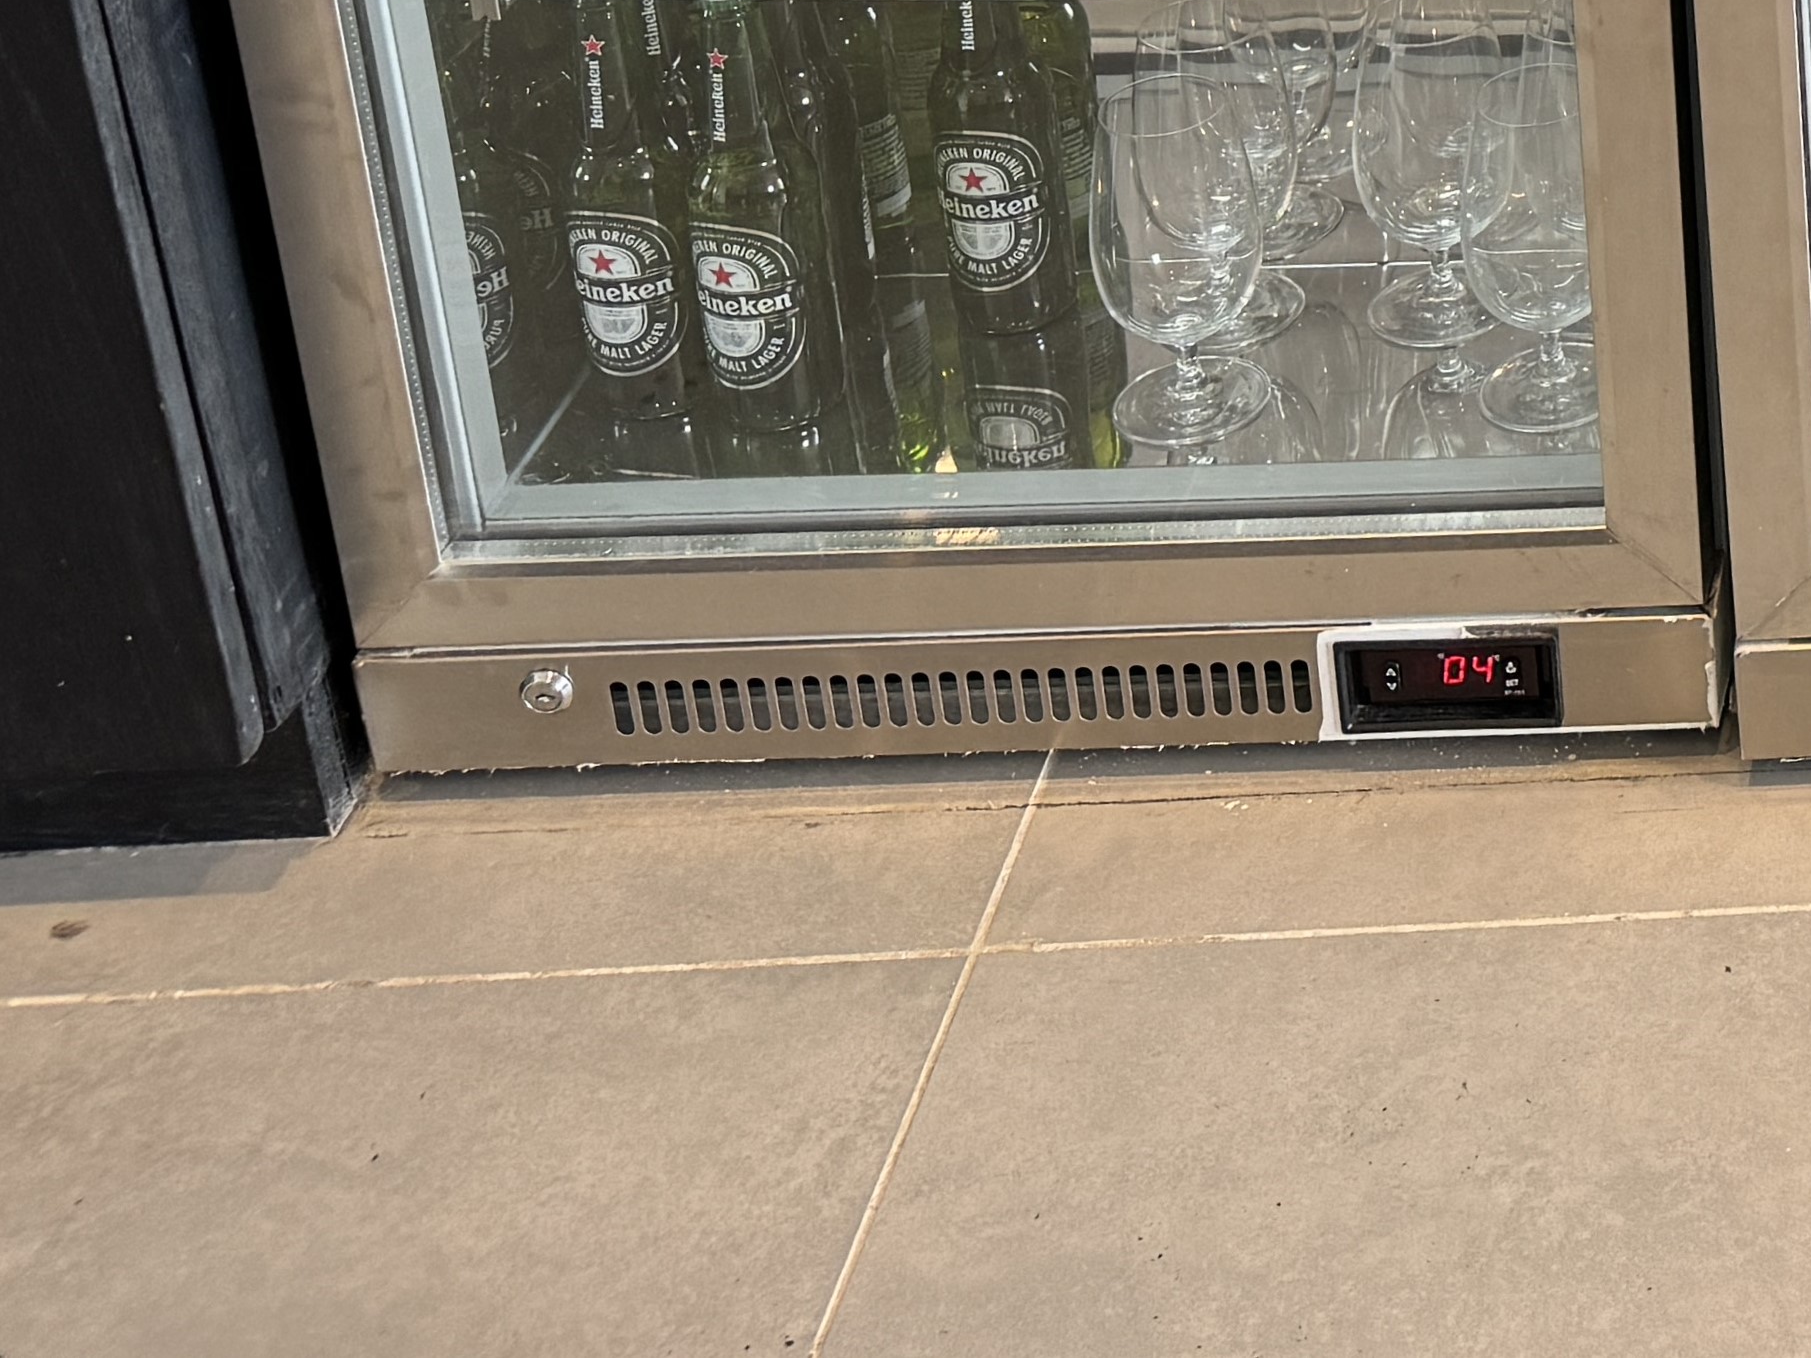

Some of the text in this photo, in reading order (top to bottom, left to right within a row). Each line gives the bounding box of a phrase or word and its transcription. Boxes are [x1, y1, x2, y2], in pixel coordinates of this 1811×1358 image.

[958, 0, 975, 52] Heinek
[587, 60, 605, 130] Heineken
[711, 73, 727, 143] Heineken
[972, 147, 1027, 182] ORIGINAL
[600, 228, 659, 266] ORIGINAL
[721, 242, 779, 280] ORIGINAL
[967, 236, 1033, 276] MALT LAGER
[576, 276, 675, 303] eineken
[697, 290, 793, 317] eineken
[600, 320, 669, 361] MALT LAGER
[718, 334, 786, 373] MALT LAGER
[1442, 655, 1495, 685] 04
